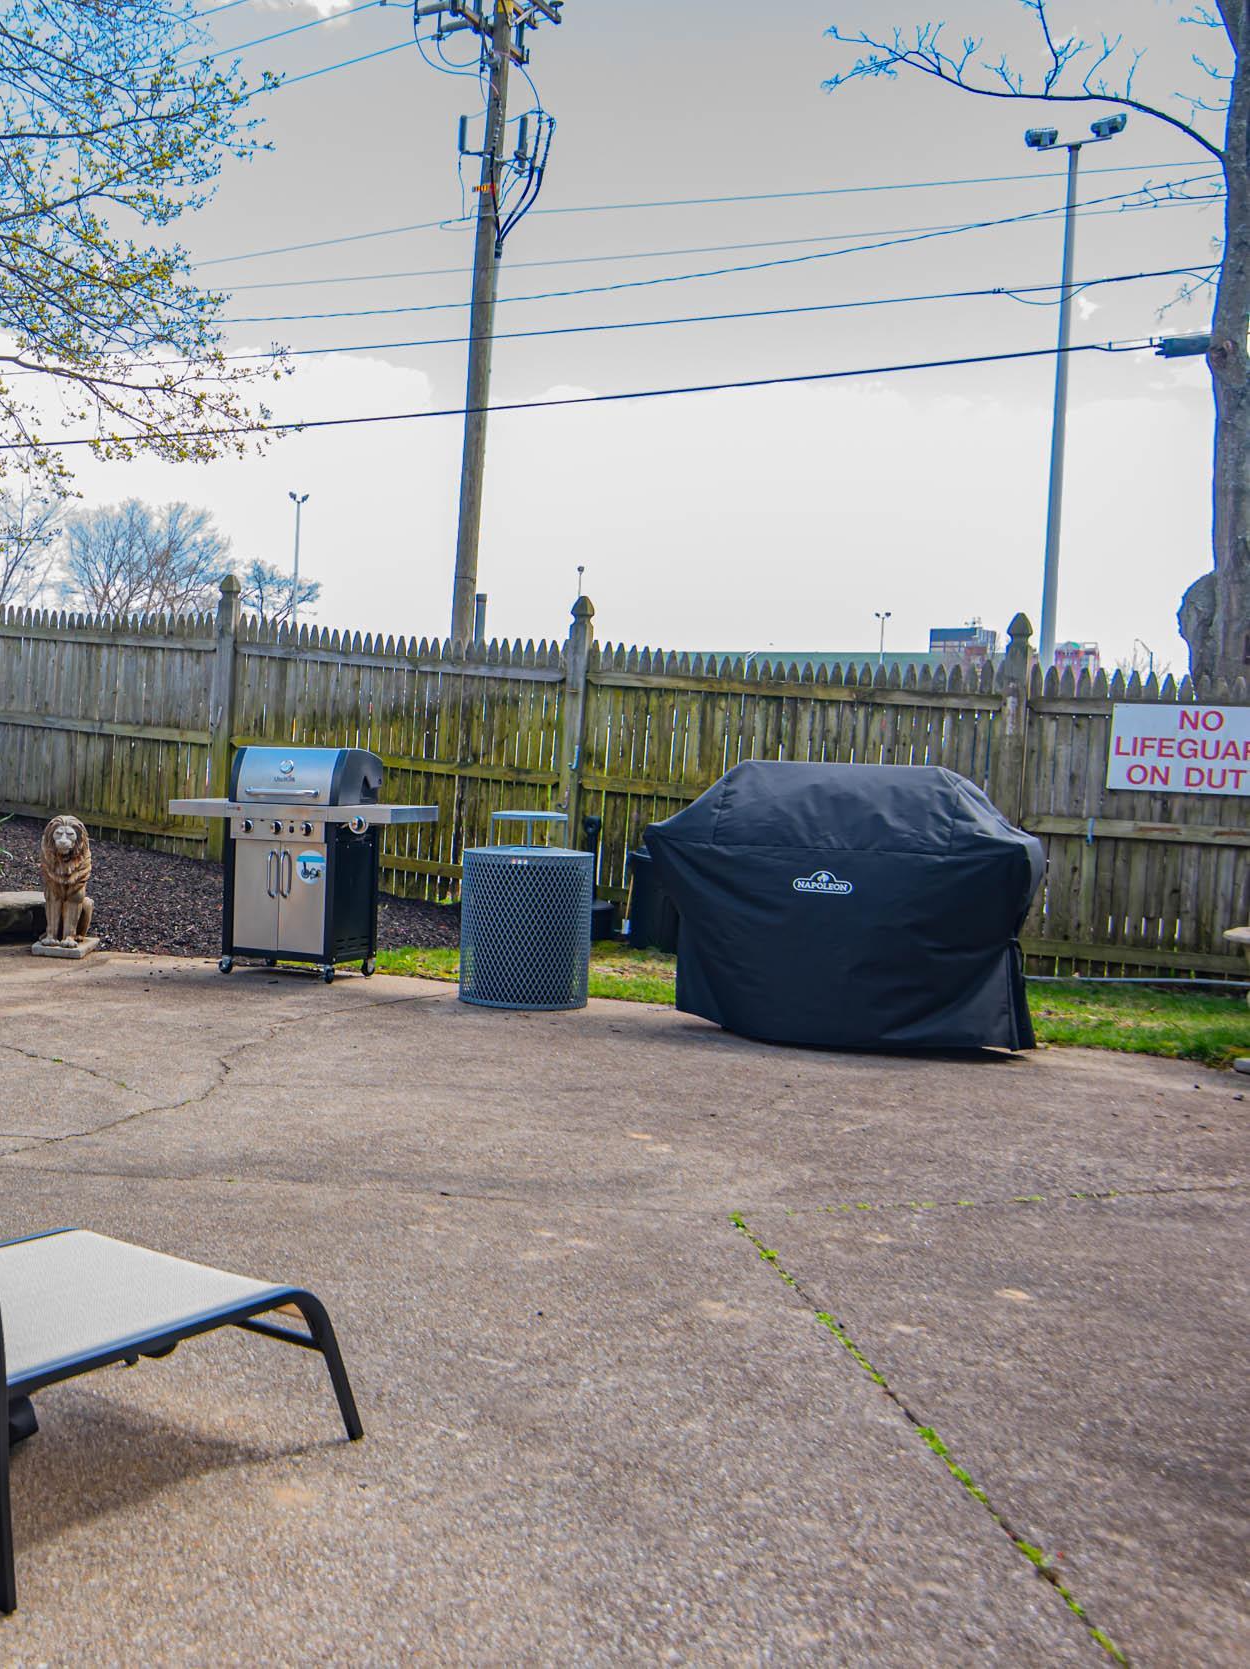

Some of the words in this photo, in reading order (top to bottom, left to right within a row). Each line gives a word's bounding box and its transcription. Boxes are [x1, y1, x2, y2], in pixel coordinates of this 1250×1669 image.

[1179, 710, 1225, 731] NO
[1126, 764, 1170, 786] ON
[1184, 767, 1249, 789] DUT
[797, 880, 848, 892] NAPOLEON
